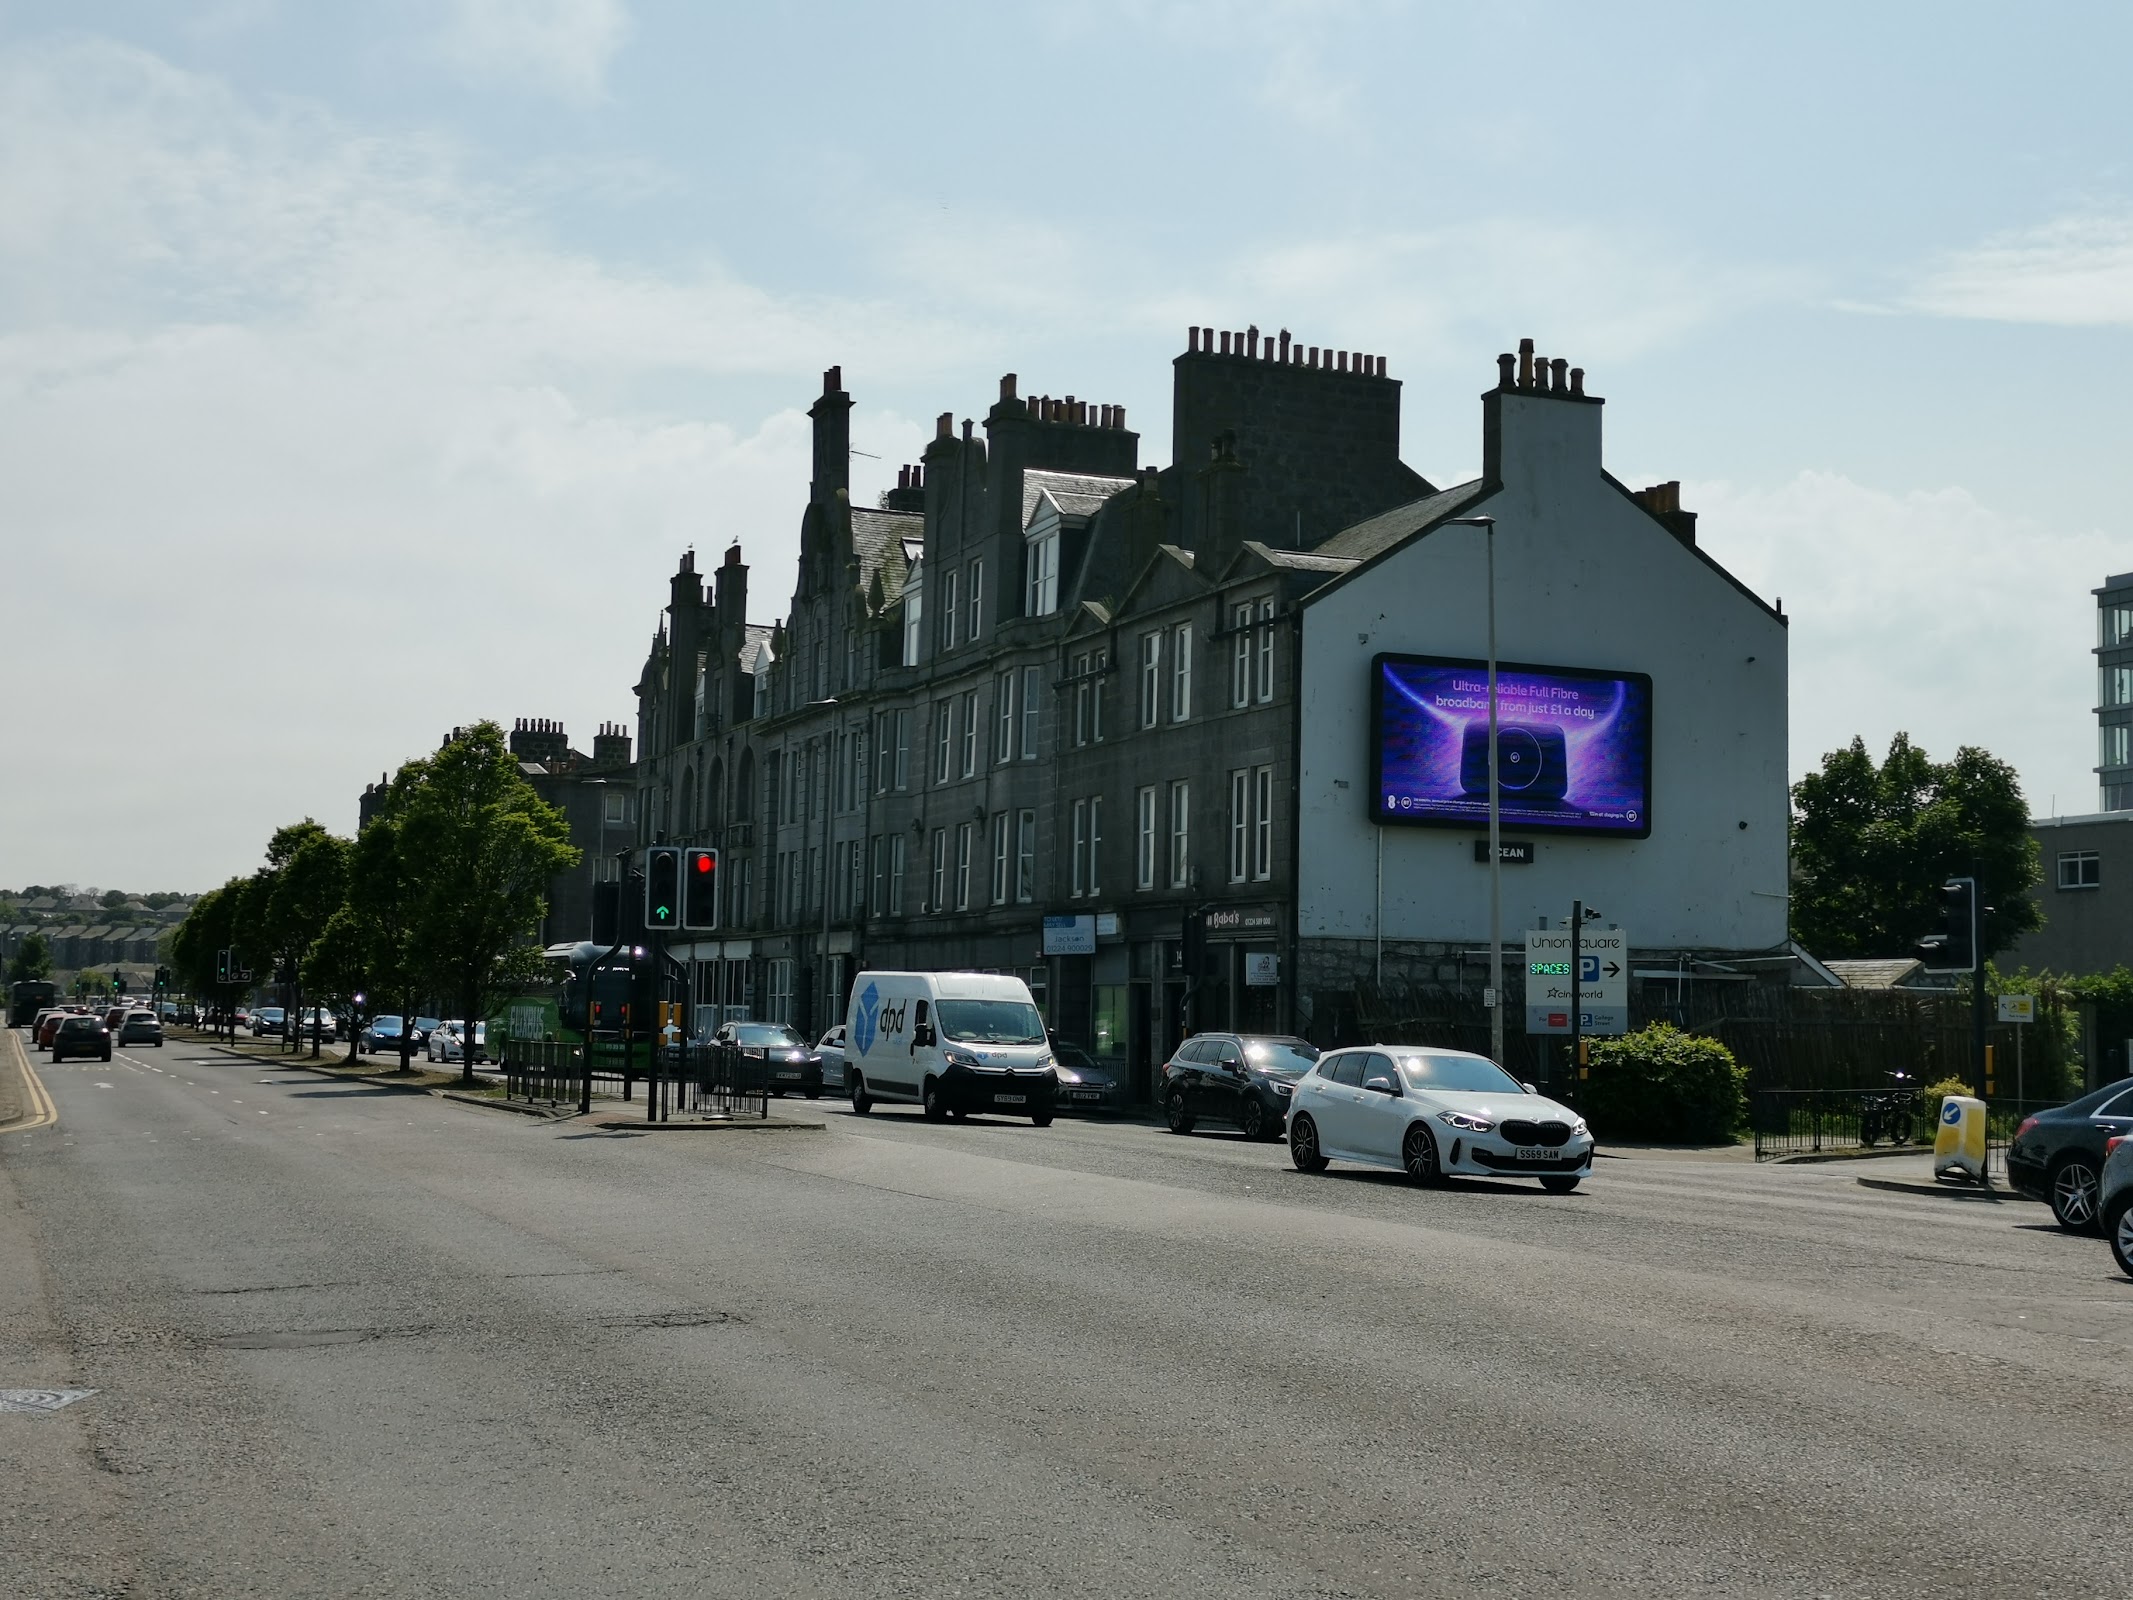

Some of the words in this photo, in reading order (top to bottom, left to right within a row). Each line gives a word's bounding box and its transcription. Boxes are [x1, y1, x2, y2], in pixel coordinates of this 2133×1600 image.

[1530, 686, 1548, 698] Full
[1551, 687, 1578, 700] Fibre
[1500, 700, 1526, 713] from
[1528, 703, 1548, 715] just
[1550, 704, 1562, 715] £1
[1564, 708, 1571, 716] a
[1574, 706, 1595, 720] day
[1489, 848, 1524, 858] CEAN
[1213, 910, 1240, 928] Baba's
[1067, 944, 1093, 952] 900029
[1576, 938, 1620, 950] quare
[1530, 963, 1570, 975] SPACES
[1557, 990, 1603, 999] cinworld
[880, 998, 907, 1042] dpd
[991, 1051, 1008, 1060] dpd
[1520, 1150, 1542, 1159] SS69
